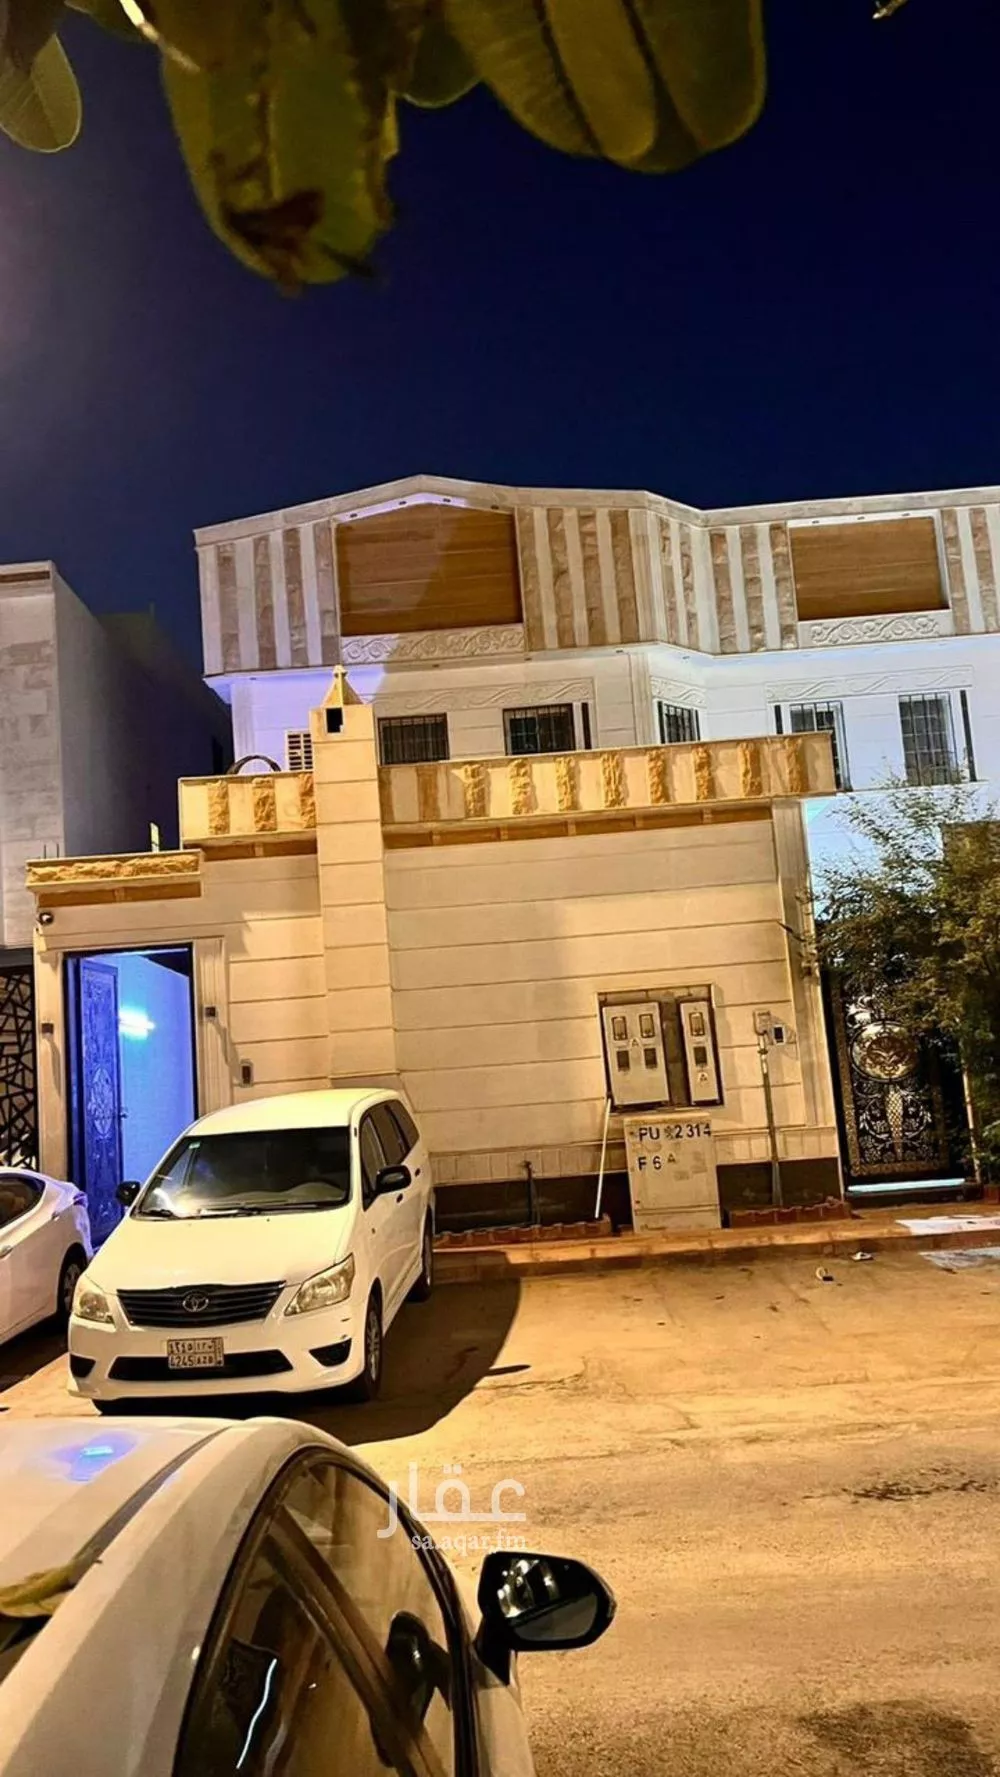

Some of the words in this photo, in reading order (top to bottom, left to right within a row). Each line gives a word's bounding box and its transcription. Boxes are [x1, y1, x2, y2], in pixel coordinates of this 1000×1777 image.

[638, 1126, 660, 1141] PU
[637, 1156, 647, 1171] F
[653, 1155, 662, 1170] 6
